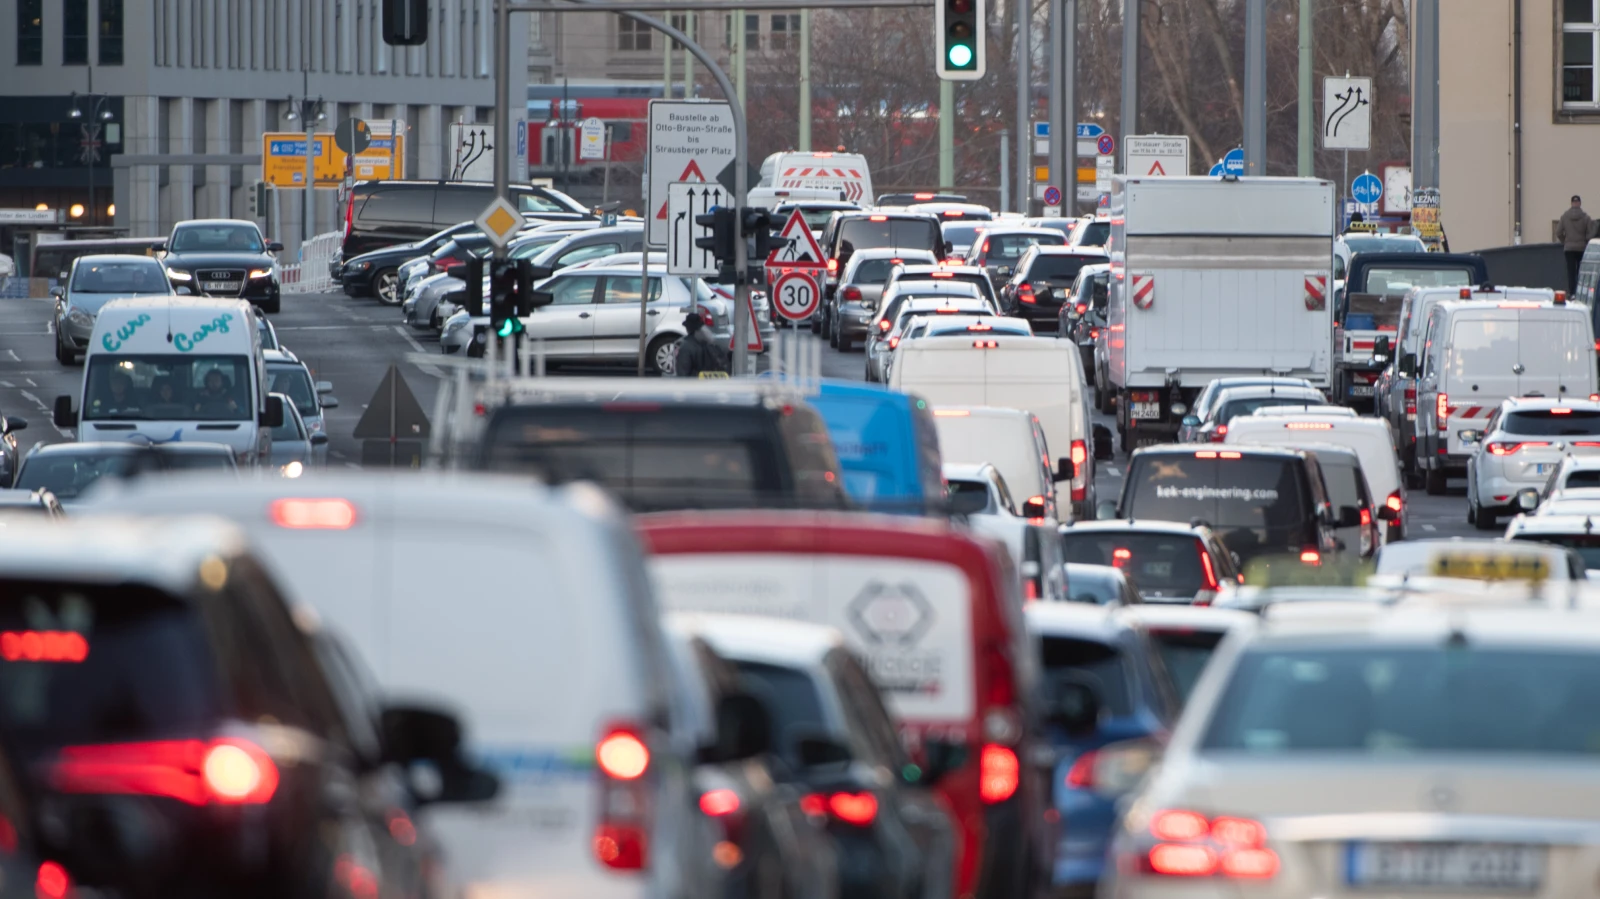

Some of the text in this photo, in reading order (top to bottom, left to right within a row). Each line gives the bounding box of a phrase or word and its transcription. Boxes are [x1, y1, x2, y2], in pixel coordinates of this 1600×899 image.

[669, 113, 719, 122] Baustelle ab
[655, 123, 733, 133] Otto-Braun-Straße
[687, 135, 700, 144] bis
[655, 145, 732, 156] Strausberger Platz
[607, 213, 615, 225] P
[783, 285, 810, 307] 30
[101, 313, 234, 352] Euro Cargo
[1156, 485, 1279, 501] kek-engineering.com
